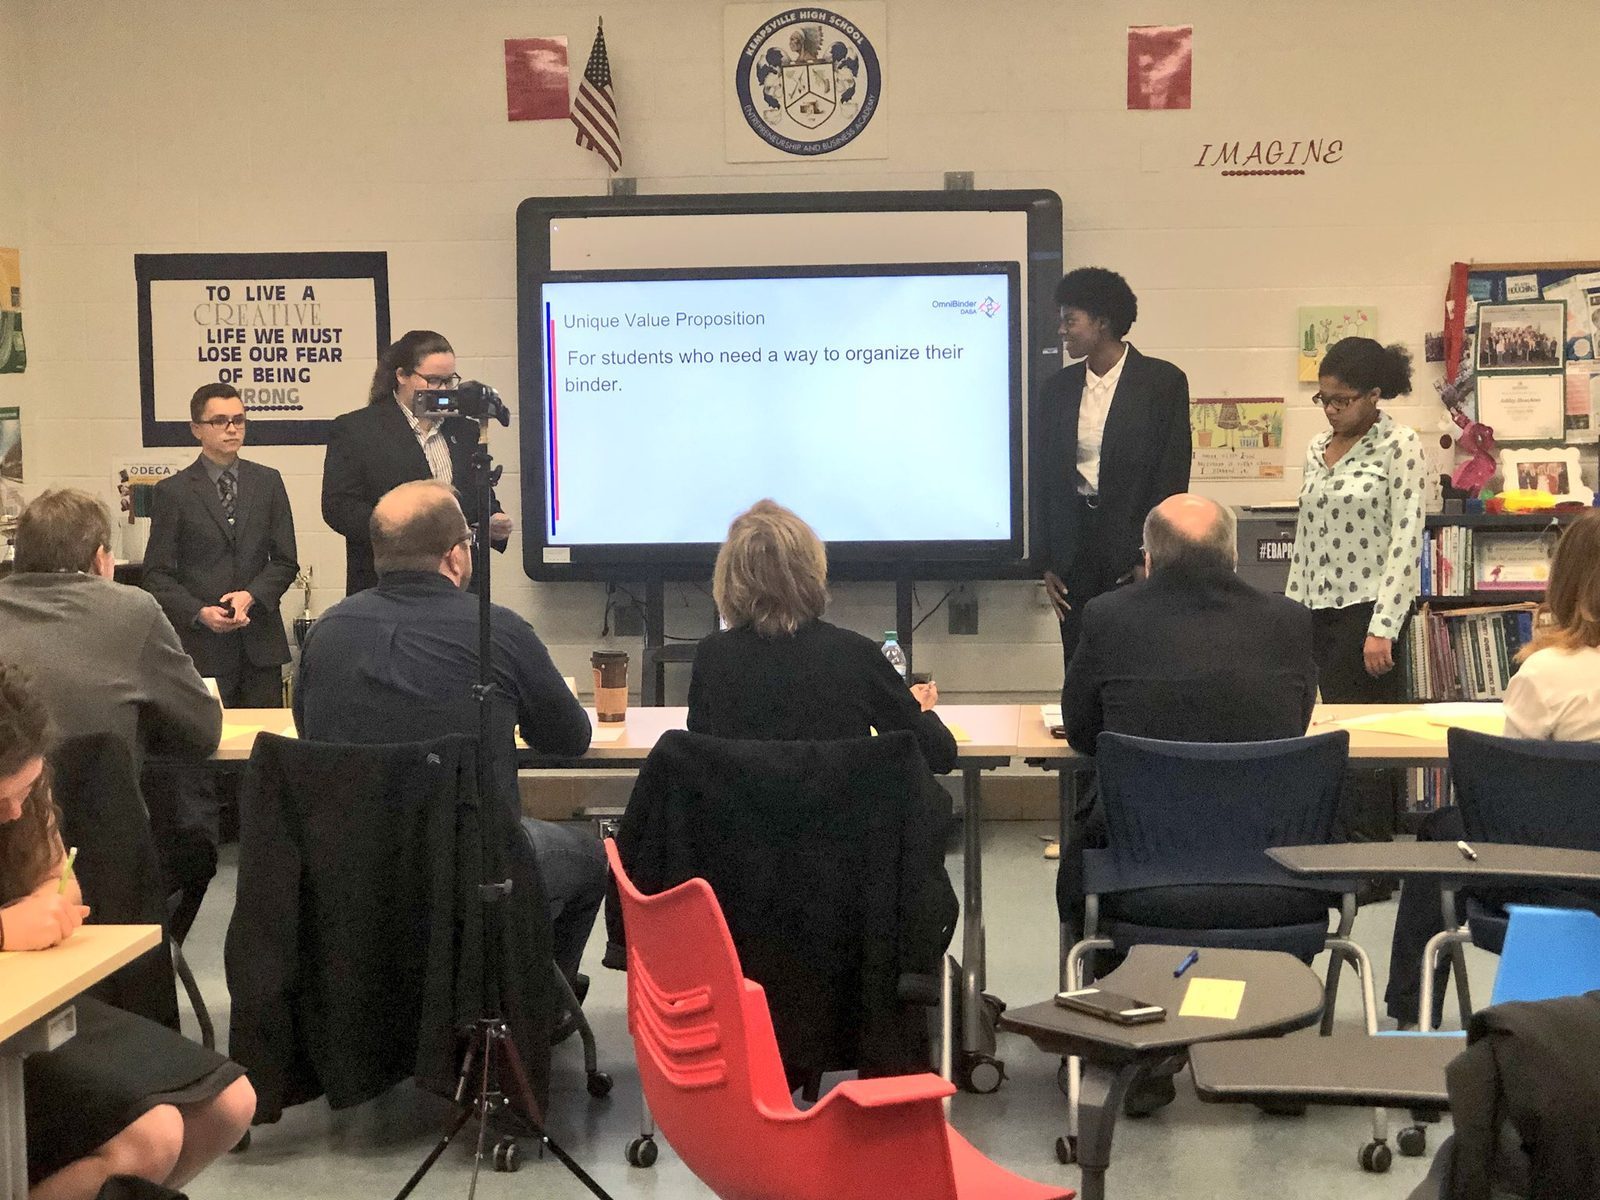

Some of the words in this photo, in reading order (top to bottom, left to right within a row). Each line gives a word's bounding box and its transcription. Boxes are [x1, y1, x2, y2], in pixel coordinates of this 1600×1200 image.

[745, 13, 797, 57] KEMPSVILLE
[800, 11, 827, 21] HIGH
[829, 16, 865, 45] SCHOOL
[744, 104, 801, 151] ENTREPRENEURSHIP
[803, 144, 821, 152] AND
[822, 128, 856, 151] BUSINESS
[855, 94, 877, 132] ACADEMY
[1194, 138, 1343, 166] IMAGINE
[206, 285, 231, 301] TO
[246, 285, 286, 301] LIVE
[302, 285, 315, 301] A
[932, 300, 977, 308] OmniBinder
[193, 303, 321, 326] CREATIVE
[564, 313, 620, 331] Unique
[624, 312, 671, 328] Value
[675, 311, 766, 329] Proposition
[207, 328, 246, 344] LIFE
[254, 328, 284, 344] WE
[292, 328, 342, 344] MUST
[198, 346, 242, 362] LOSE
[249, 346, 288, 362] OUR
[296, 347, 342, 363] FEAR
[568, 350, 596, 366] For
[601, 349, 674, 365] students
[678, 348, 714, 364] who
[719, 347, 762, 363] need
[767, 350, 779, 363] a
[783, 349, 818, 366] way
[824, 346, 840, 361] to
[845, 345, 920, 365] organize
[925, 344, 964, 360] their
[218, 368, 243, 383] OF
[253, 367, 311, 383] BEING
[565, 377, 622, 392] binder.
[140, 466, 171, 475] DECA
